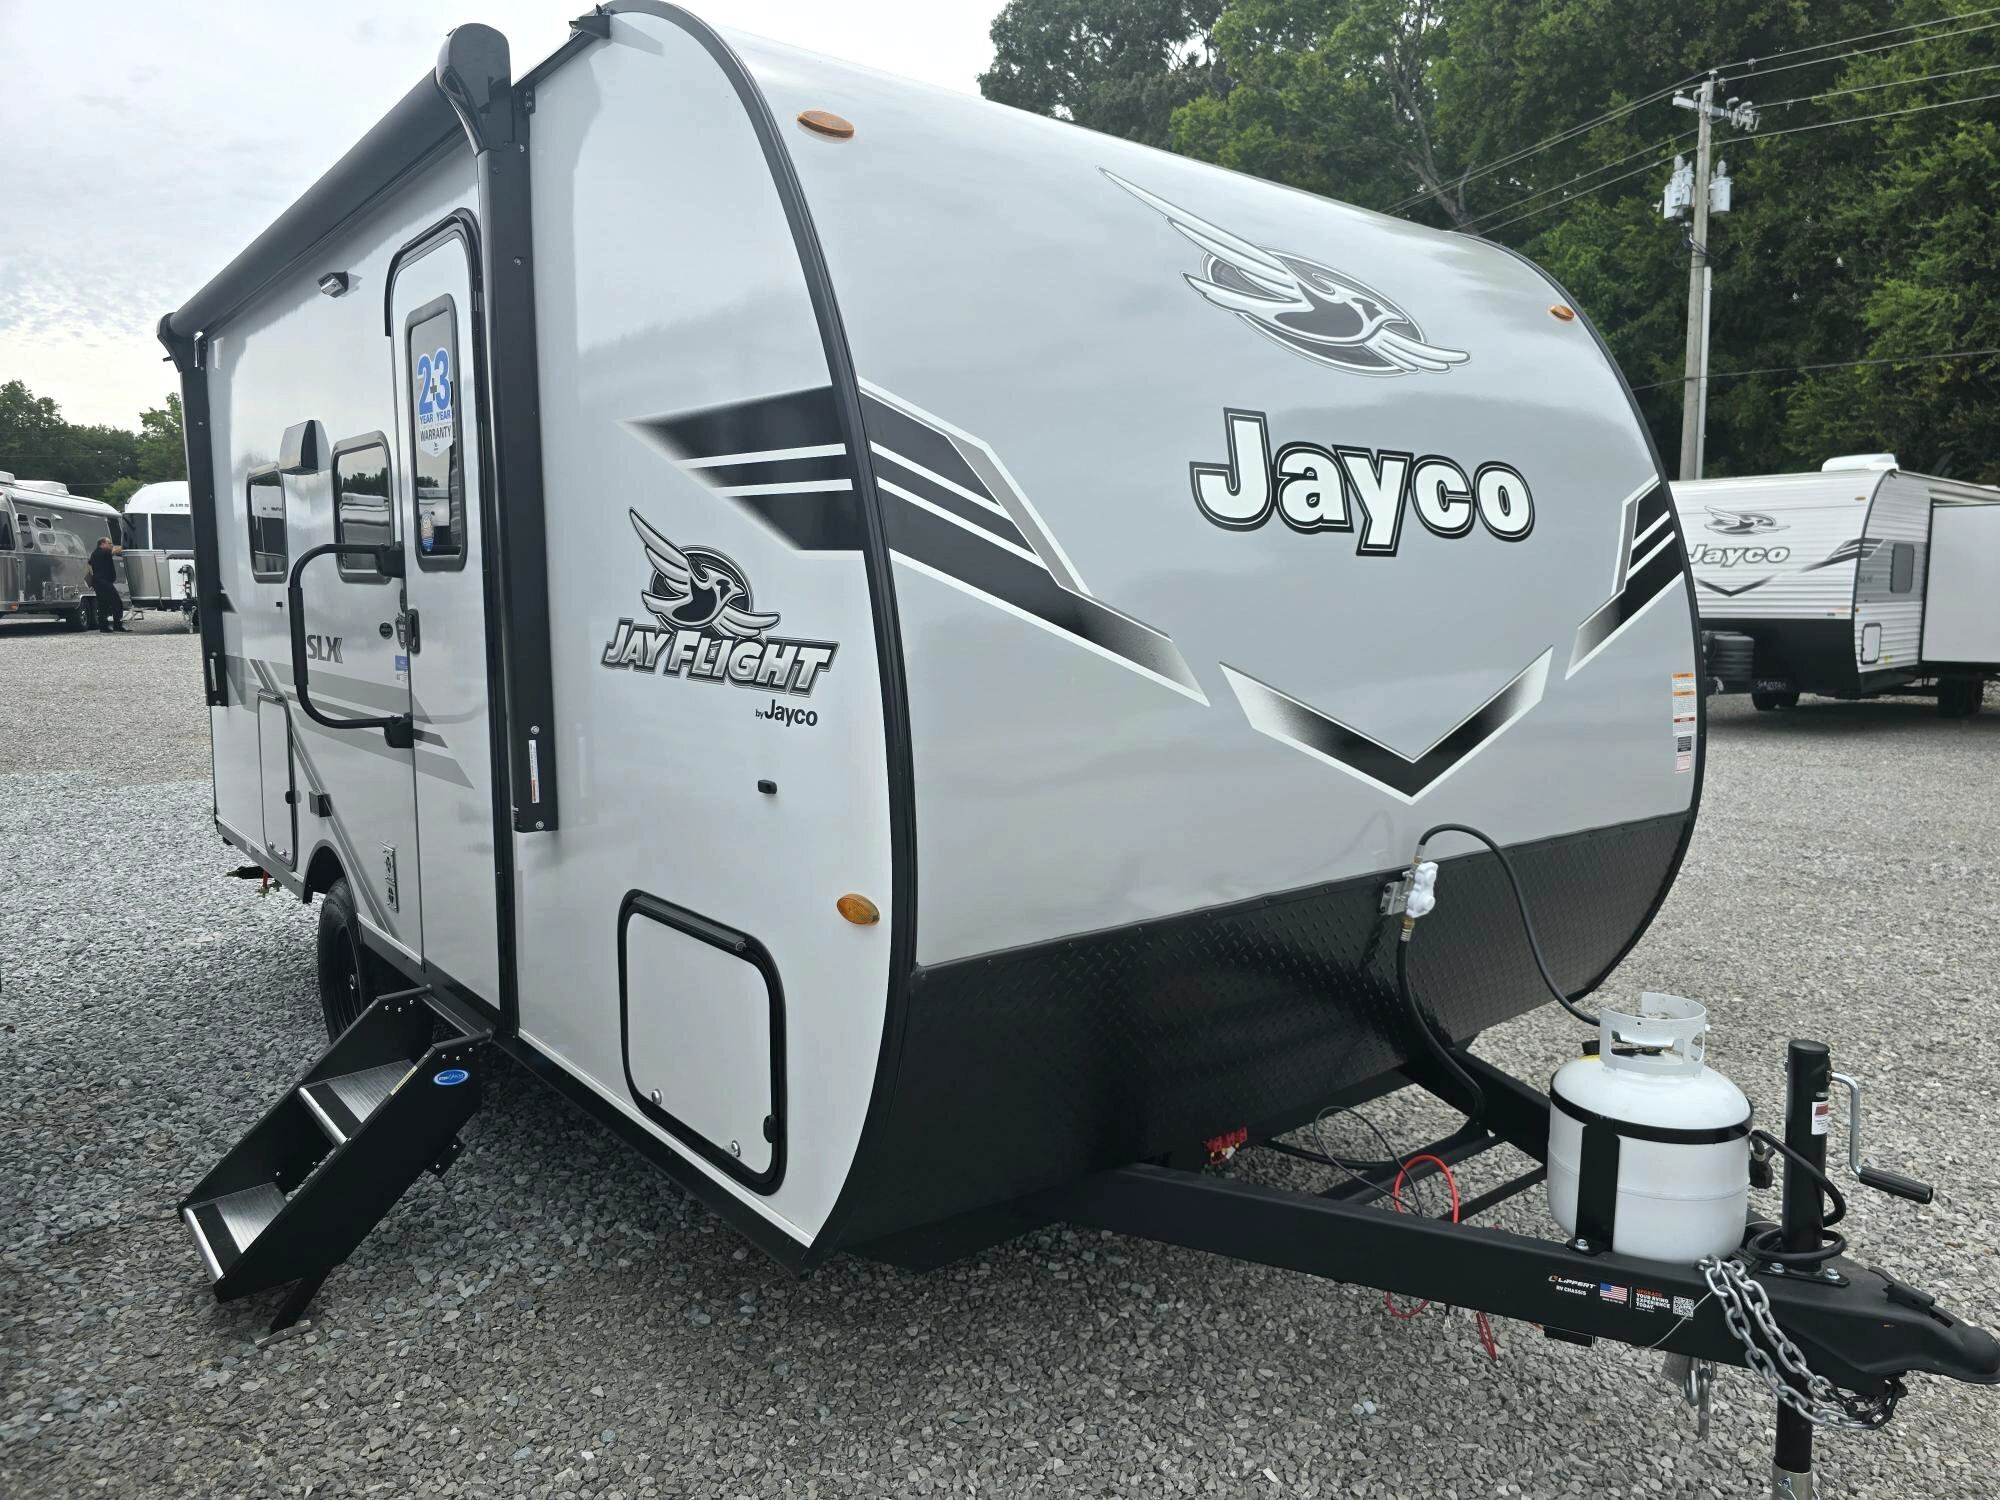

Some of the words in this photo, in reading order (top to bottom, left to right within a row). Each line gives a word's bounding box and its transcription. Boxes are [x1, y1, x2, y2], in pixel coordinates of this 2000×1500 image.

[420, 414, 434, 424] YEAR
[436, 410, 451, 421] YEAR
[420, 425, 452, 441] WARRANTY
[1189, 407, 1536, 557] Jayco
[1688, 543, 1791, 568] Jayco
[306, 634, 344, 664] SLX
[601, 617, 676, 674] JAY
[663, 628, 840, 697] FLIGHT
[755, 709, 765, 719] by
[764, 700, 819, 727] Jayco
[1564, 1287, 1587, 1296] CHASSIS
[1636, 1298, 1671, 1309] EXPERIENCE
